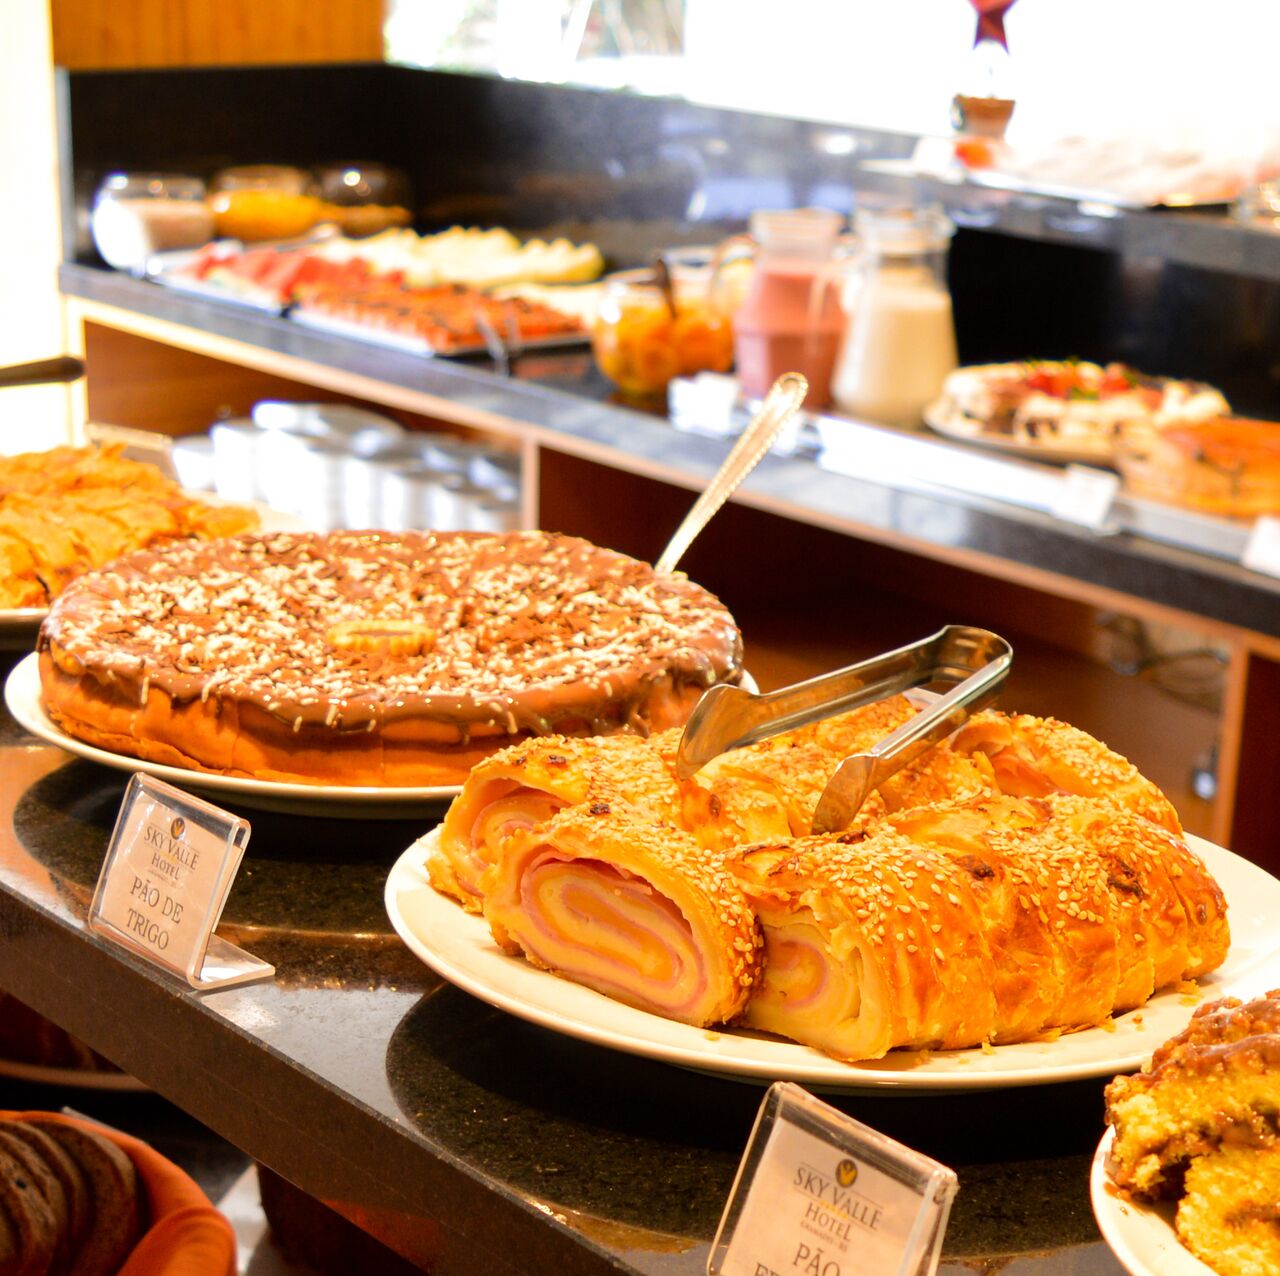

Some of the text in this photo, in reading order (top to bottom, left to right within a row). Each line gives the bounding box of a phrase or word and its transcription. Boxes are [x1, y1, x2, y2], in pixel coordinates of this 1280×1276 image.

[144, 826, 200, 870] SKY VALLE
[130, 876, 161, 908] PÃO
[161, 896, 184, 924] DE
[125, 908, 169, 950] TRIGO
[793, 1167, 882, 1231] SKY VALLE
[805, 1202, 851, 1241] HOTEL
